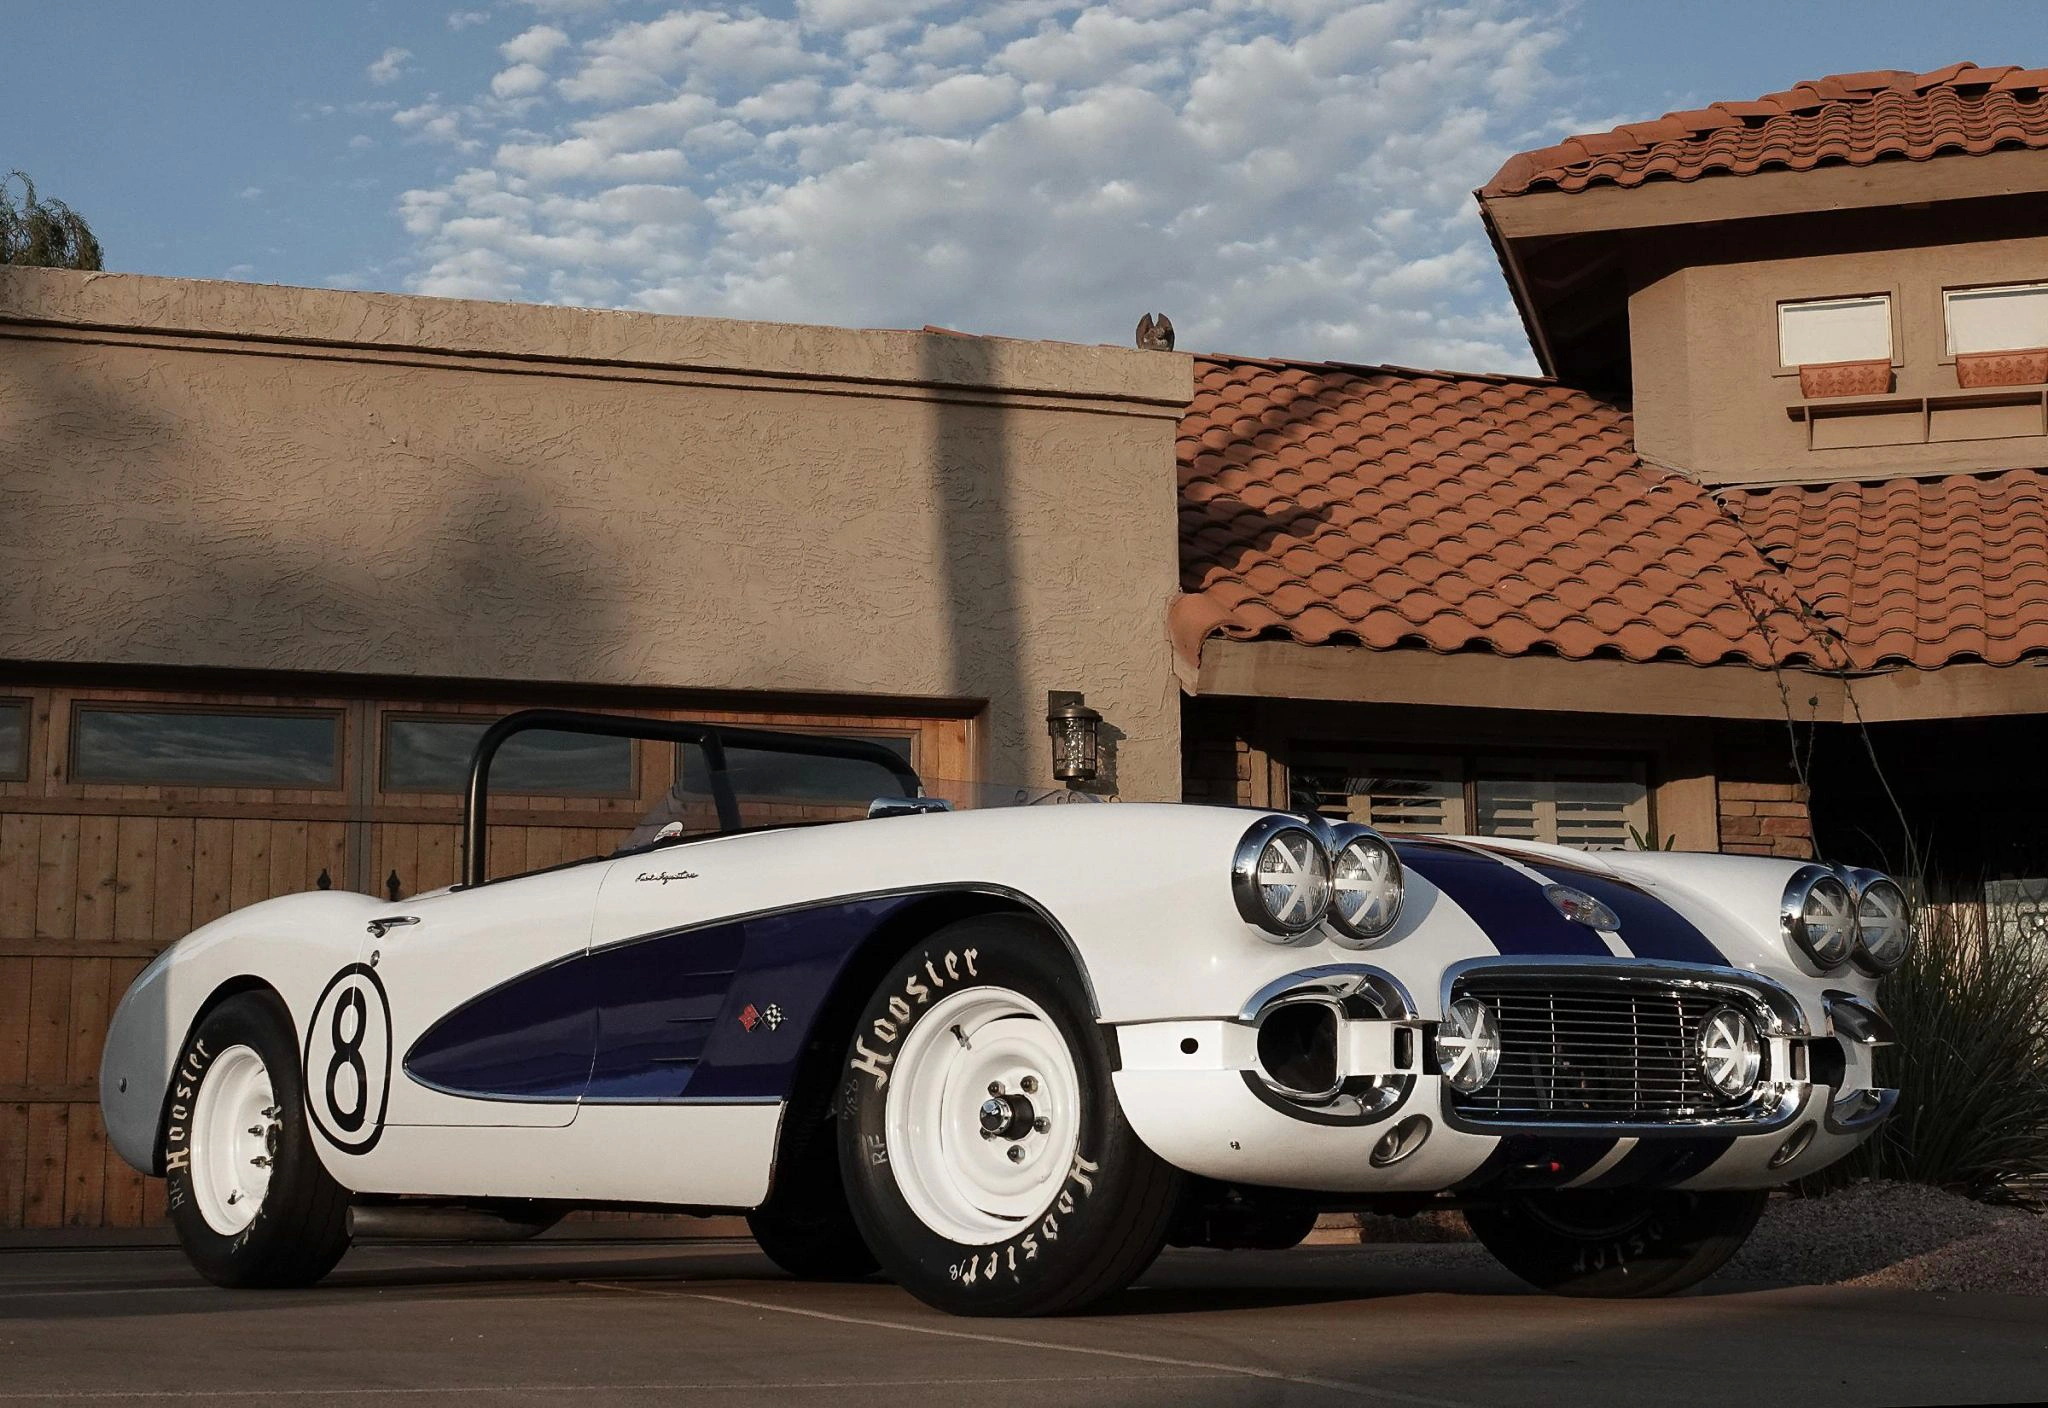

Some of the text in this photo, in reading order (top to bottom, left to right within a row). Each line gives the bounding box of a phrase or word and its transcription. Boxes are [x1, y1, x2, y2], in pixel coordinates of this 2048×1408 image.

[325, 986, 368, 1133] 8
[850, 946, 978, 1091] Hoosier
[166, 1038, 212, 1174] Hoosier
[963, 1145, 1099, 1286] Hoosier
